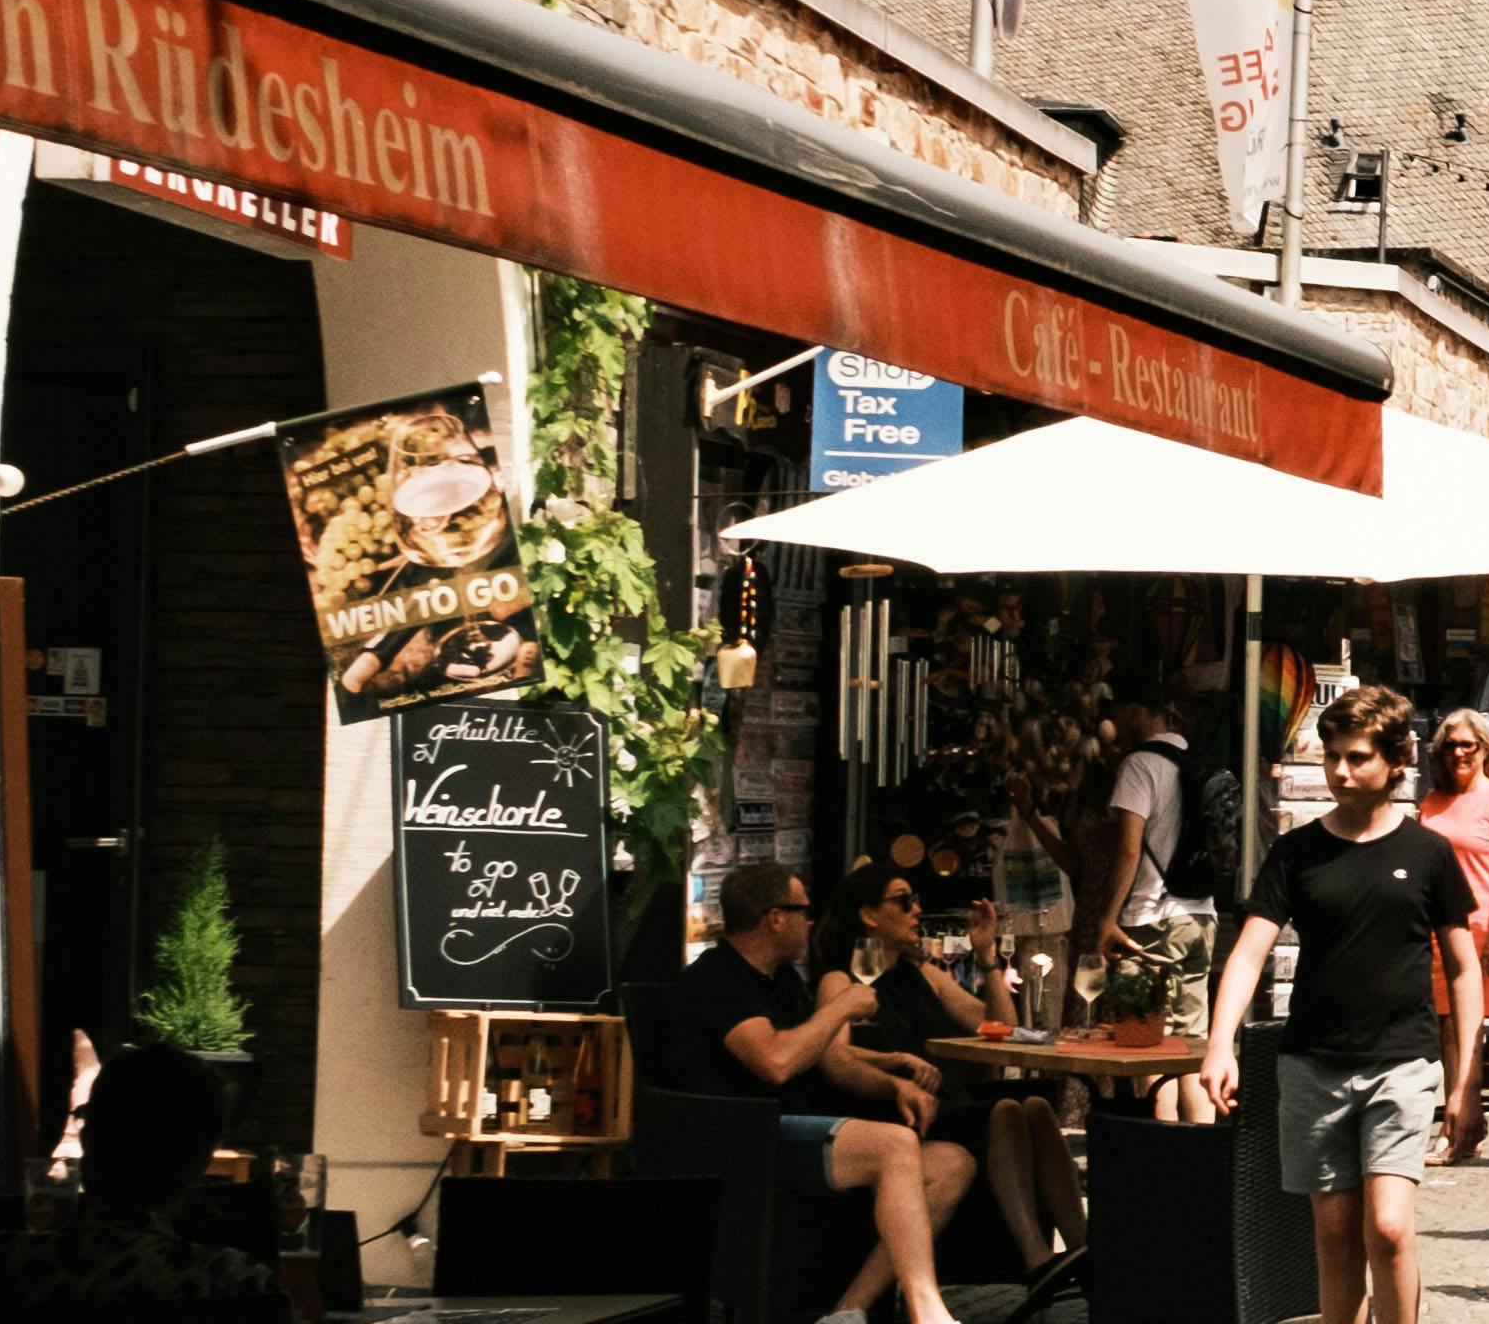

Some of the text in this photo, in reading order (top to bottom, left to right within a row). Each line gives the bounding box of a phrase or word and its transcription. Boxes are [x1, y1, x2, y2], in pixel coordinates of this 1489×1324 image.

[1003, 289, 1080, 391] Café
[1107, 321, 1258, 433] Restaurant
[838, 390, 898, 416] Tax
[843, 419, 921, 445] Free
[325, 573, 519, 640] WEIN TO GO
[404, 764, 568, 828] Weinschorle
[443, 840, 518, 898] to go
